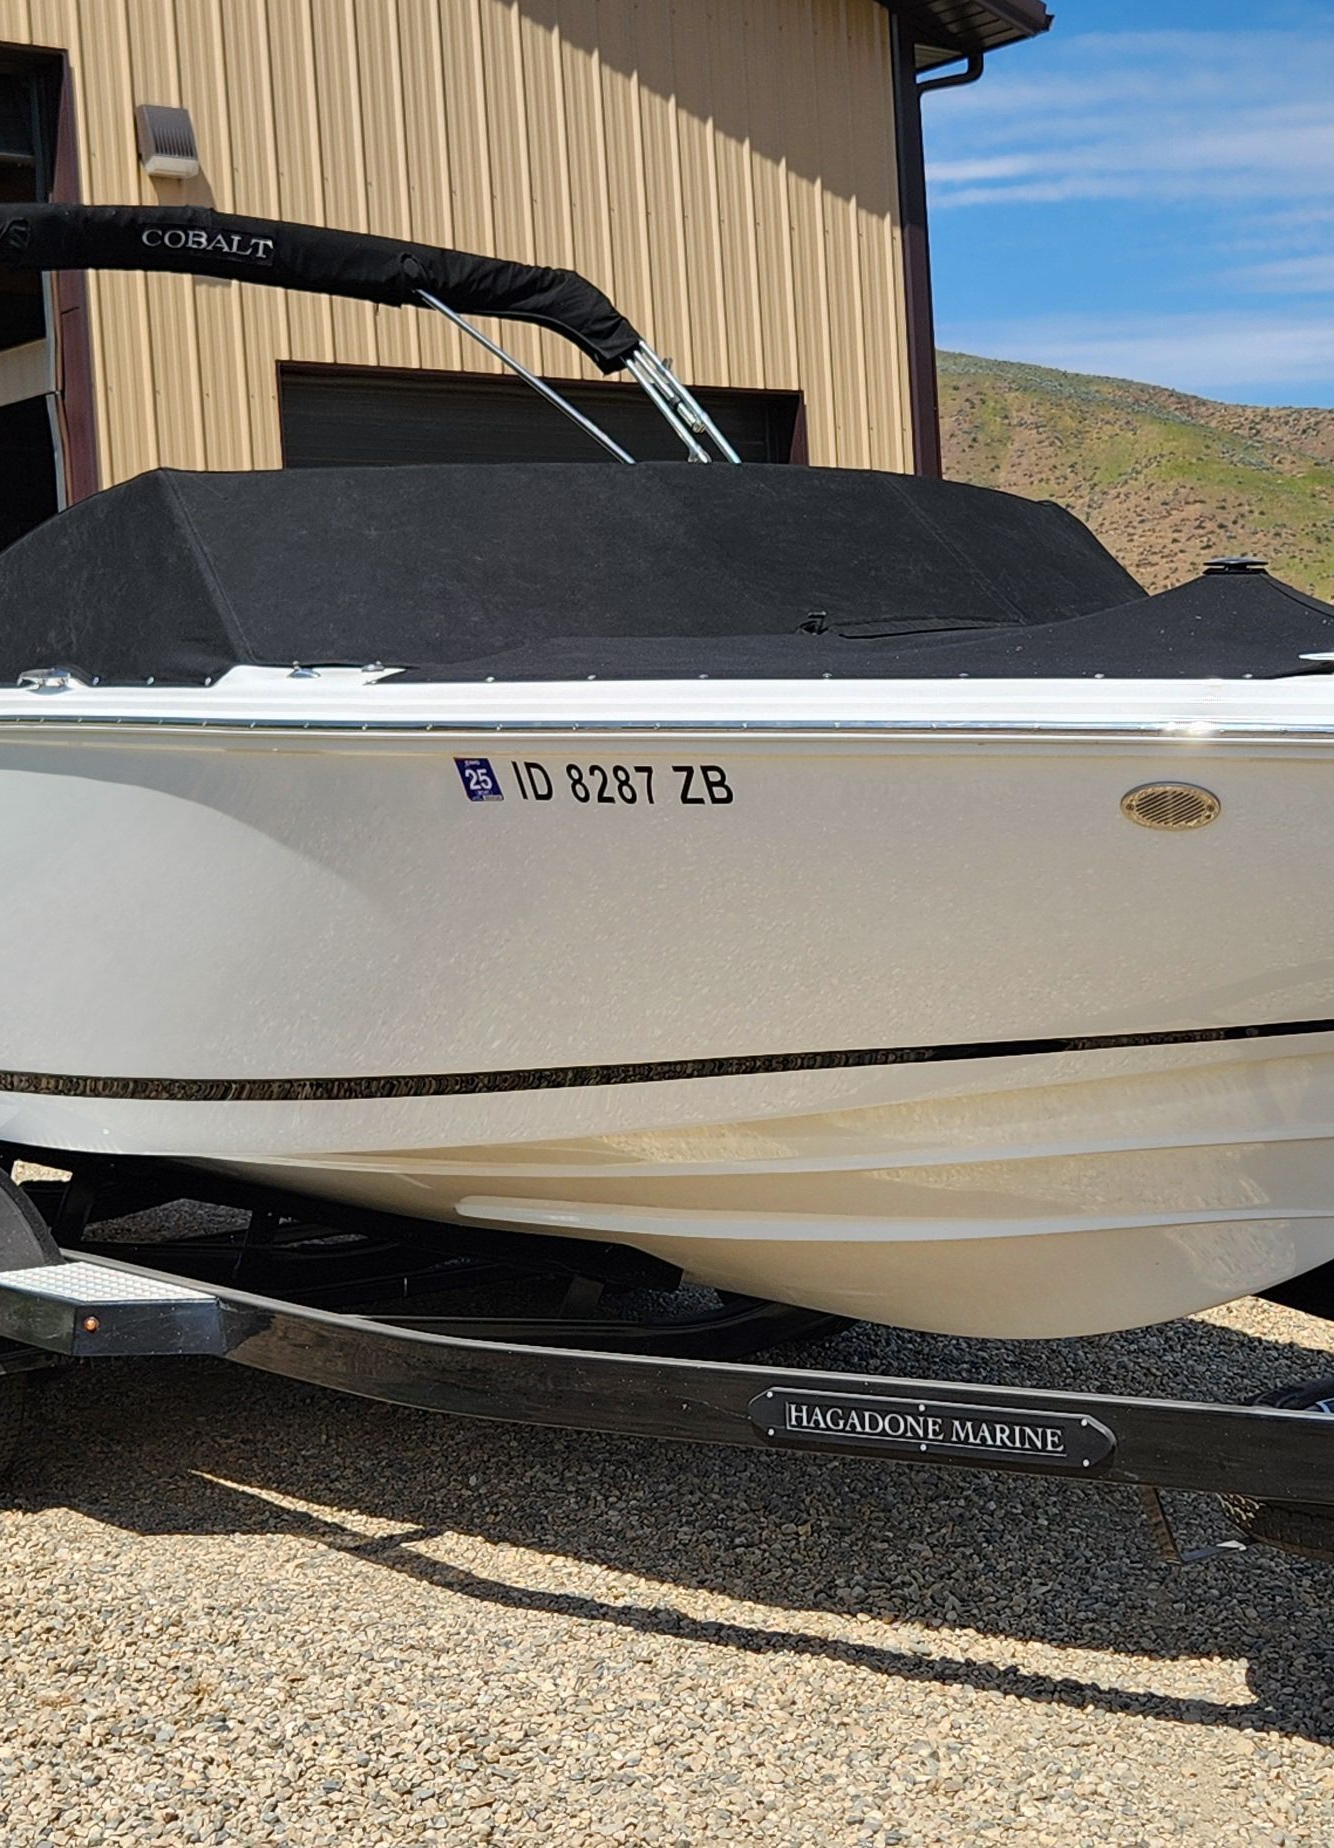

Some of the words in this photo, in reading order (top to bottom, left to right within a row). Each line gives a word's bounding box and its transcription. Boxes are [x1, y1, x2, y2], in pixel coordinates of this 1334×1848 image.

[141, 229, 274, 259] COBALT
[465, 768, 493, 791] 25
[511, 761, 554, 801] ID
[565, 763, 655, 805] 8287
[671, 764, 734, 805] ZB
[789, 1403, 945, 1441] HAGADONE
[951, 1420, 1065, 1452] MARINE
